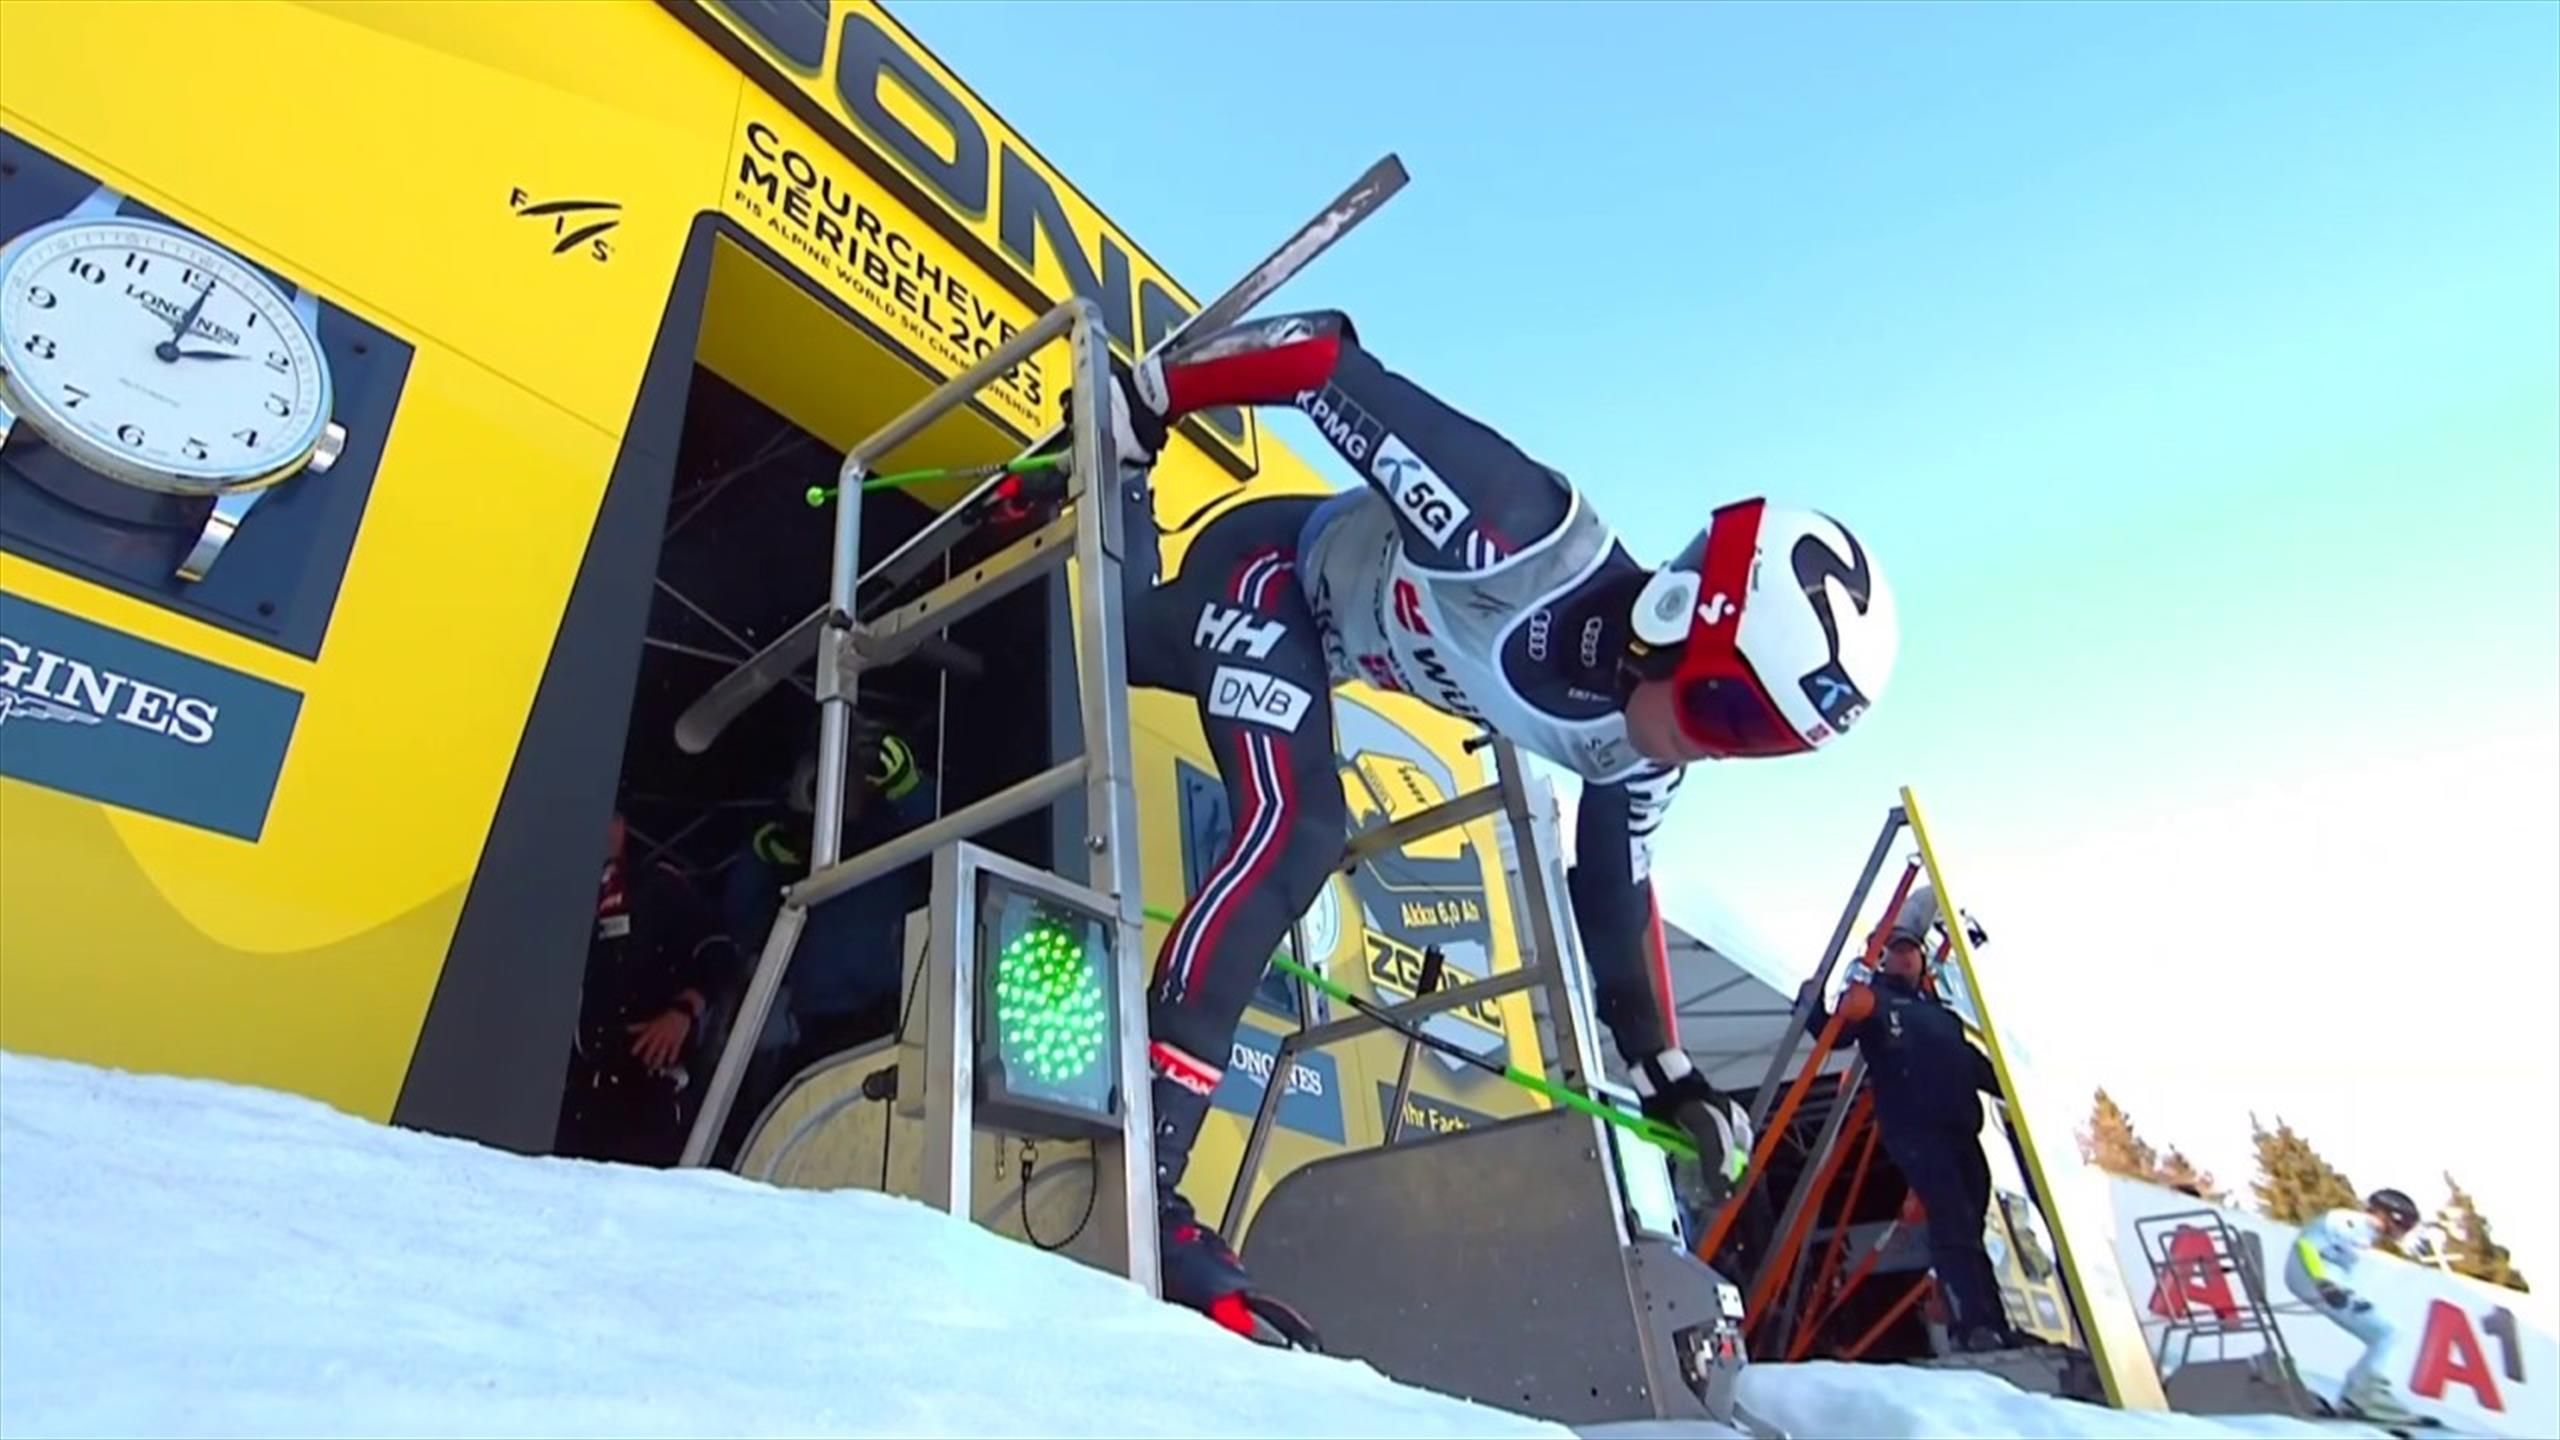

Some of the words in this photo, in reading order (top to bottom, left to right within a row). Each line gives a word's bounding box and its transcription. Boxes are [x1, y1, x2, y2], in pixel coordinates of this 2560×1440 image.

[68, 256, 107, 285] 10
[124, 252, 150, 275] 11
[27, 285, 57, 310] 9
[735, 190, 762, 218] FIS
[767, 216, 831, 269] ALPINE
[836, 265, 897, 319] WORLD
[900, 314, 926, 341] SKI
[928, 336, 1041, 428] CHAMONSHIPS
[125, 283, 240, 345] LONGNES
[24, 333, 57, 360] 8
[63, 383, 90, 409] 7
[264, 393, 290, 418] 3
[117, 424, 146, 448] 6
[1296, 389, 1368, 460] KPMG
[181, 437, 209, 461] 5
[232, 429, 260, 449] 4
[1404, 481, 1453, 535] 5G
[1194, 602, 1288, 660] HH
[1219, 677, 1292, 716] DNB
[2409, 1298, 2526, 1412] A1
